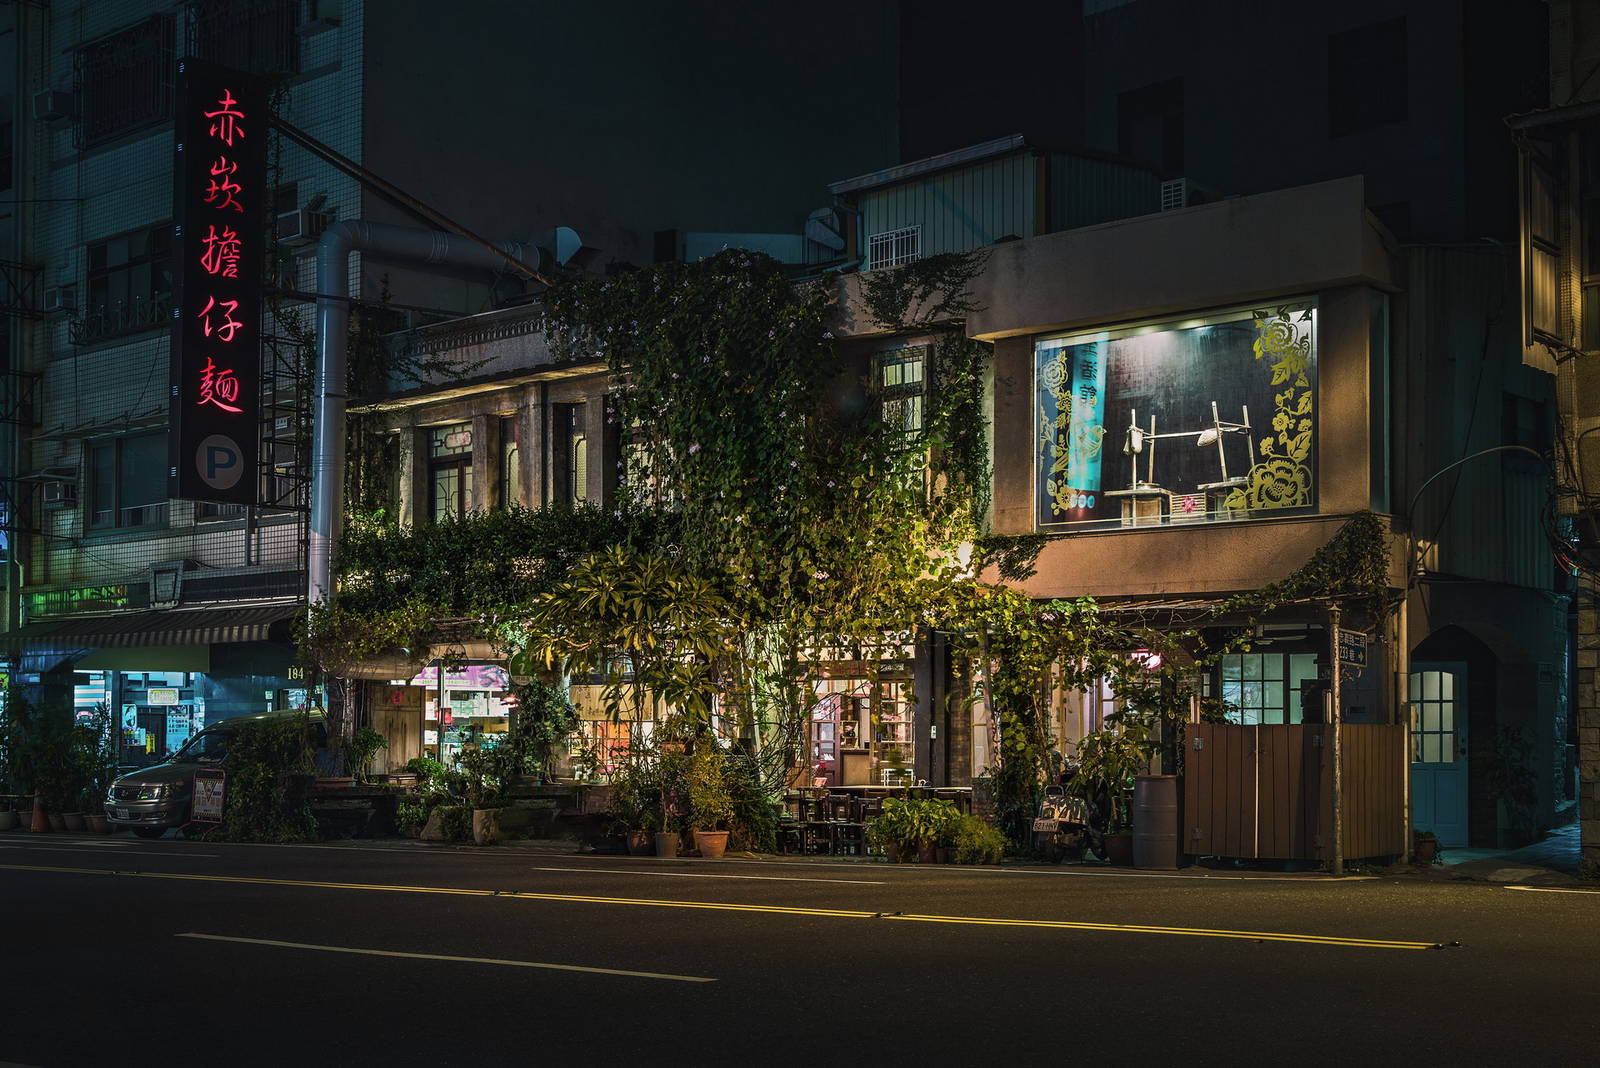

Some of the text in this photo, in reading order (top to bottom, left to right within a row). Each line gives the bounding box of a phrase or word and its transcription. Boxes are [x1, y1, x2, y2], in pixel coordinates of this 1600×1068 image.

[196, 88, 245, 412] 赤崁擔仔麵
[206, 446, 237, 480] P
[287, 667, 304, 680] 184
